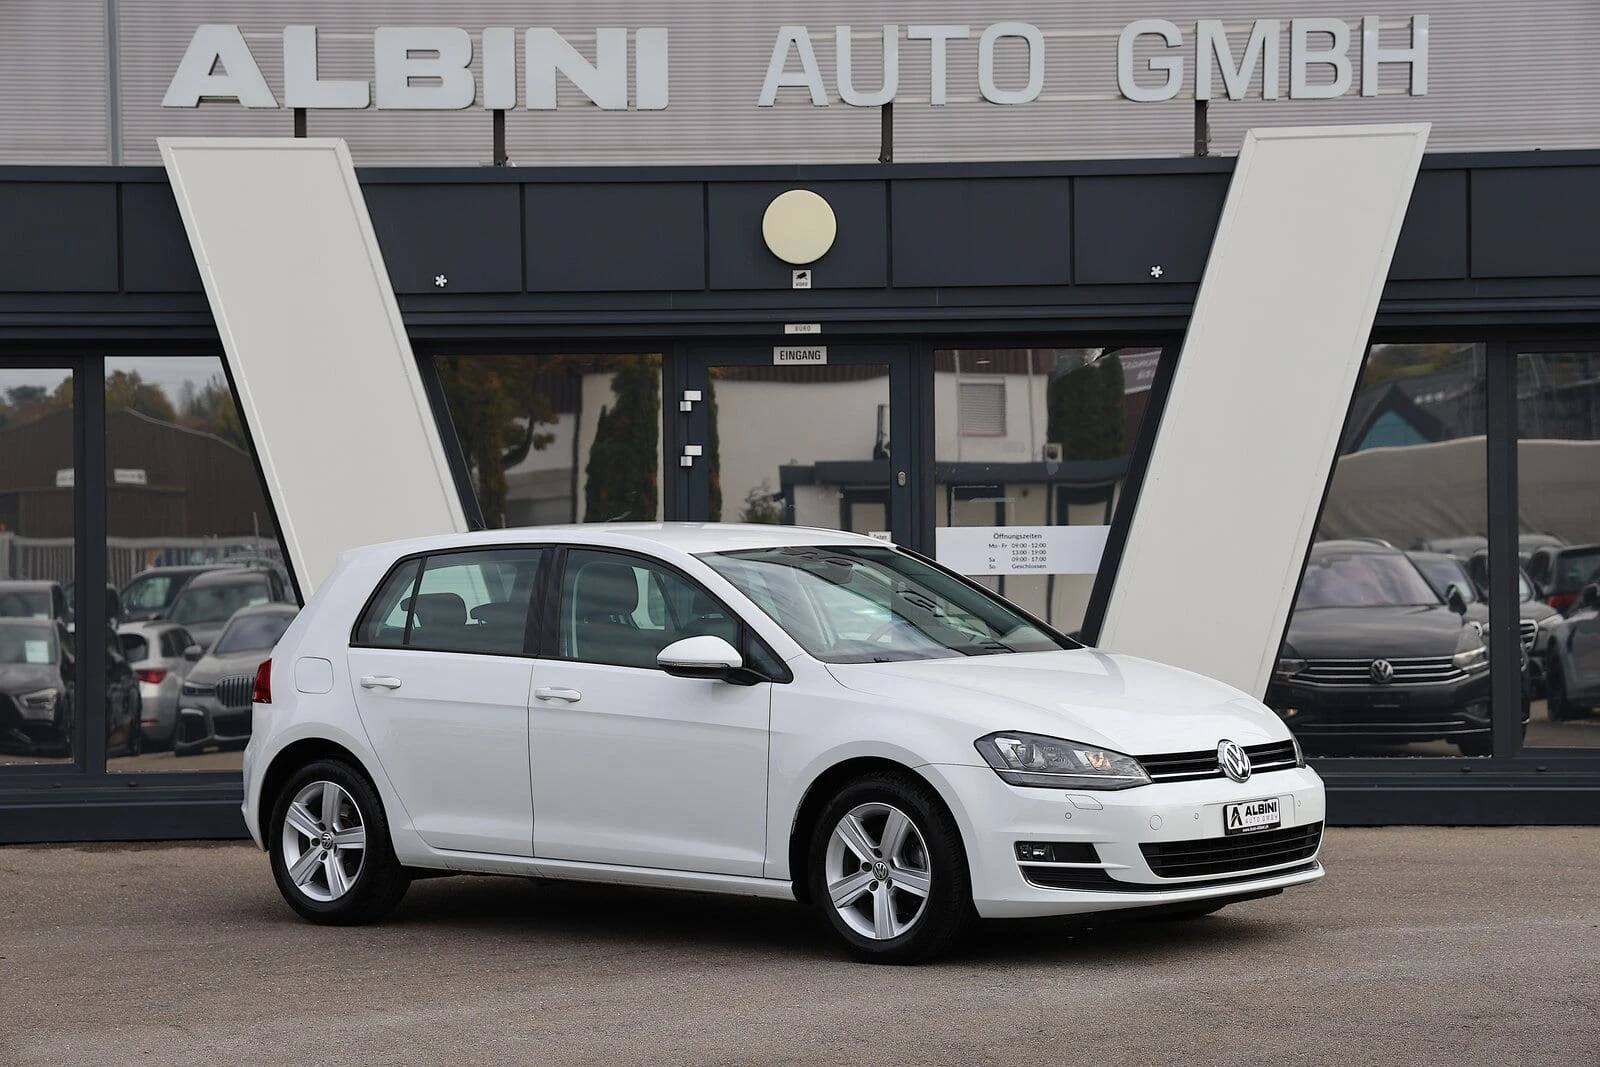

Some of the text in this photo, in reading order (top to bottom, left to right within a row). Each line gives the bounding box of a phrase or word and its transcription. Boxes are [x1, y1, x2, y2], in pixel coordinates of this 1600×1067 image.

[161, 15, 1429, 111] ALBINI AUTO GMBH
[780, 350, 821, 361] EINGANG
[993, 531, 1042, 540] Öffnungszeiten
[1245, 802, 1277, 816] ALBINI
